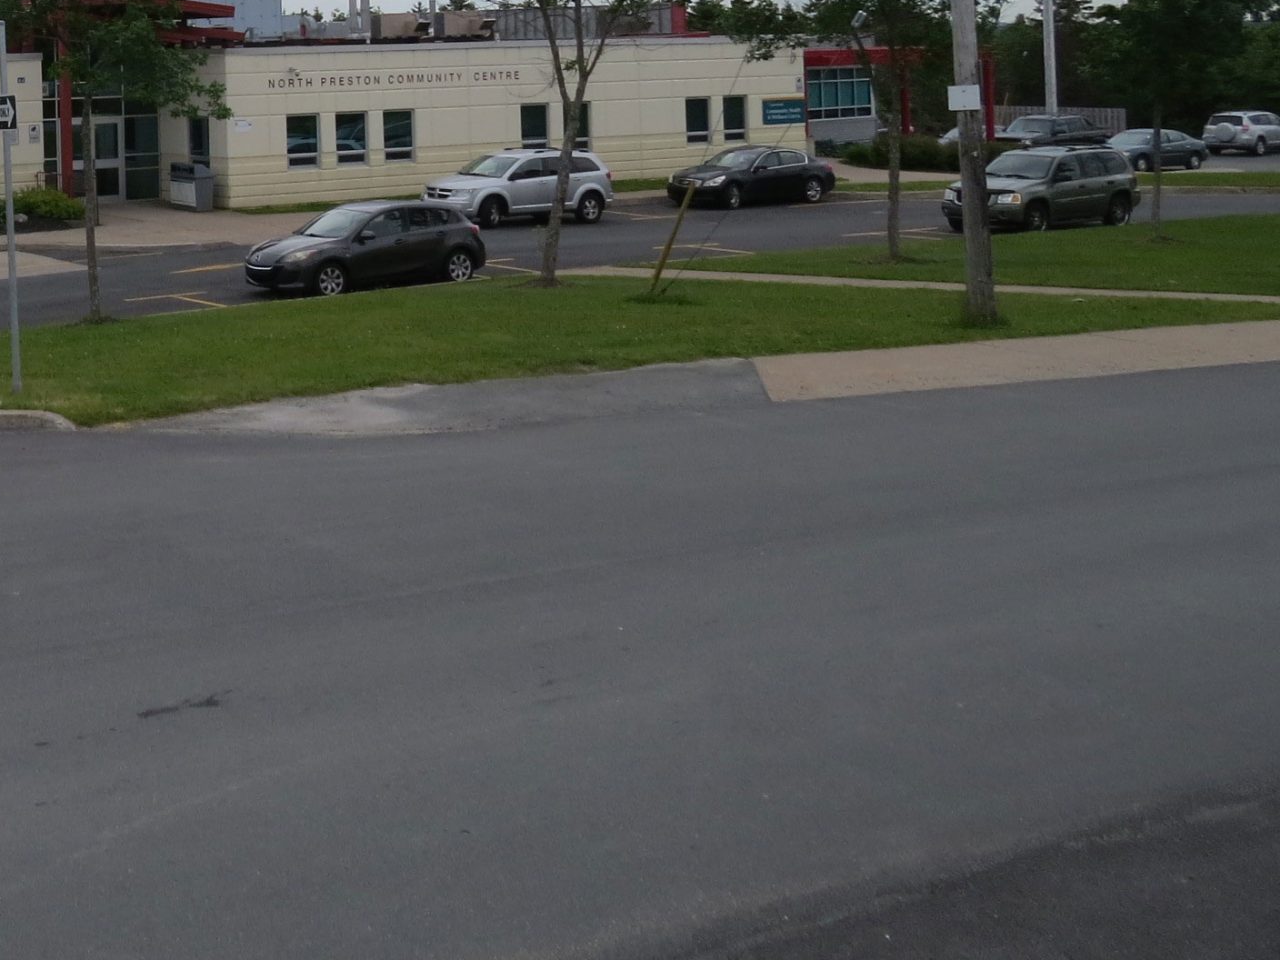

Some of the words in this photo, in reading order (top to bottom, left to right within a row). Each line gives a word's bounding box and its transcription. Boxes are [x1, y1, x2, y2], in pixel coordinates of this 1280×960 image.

[268, 78, 313, 88] NORTH
[321, 75, 381, 87] PRESTON
[387, 72, 463, 84] COMMUNITY
[473, 70, 521, 81] CENTRE
[0, 107, 10, 118] ONLY
